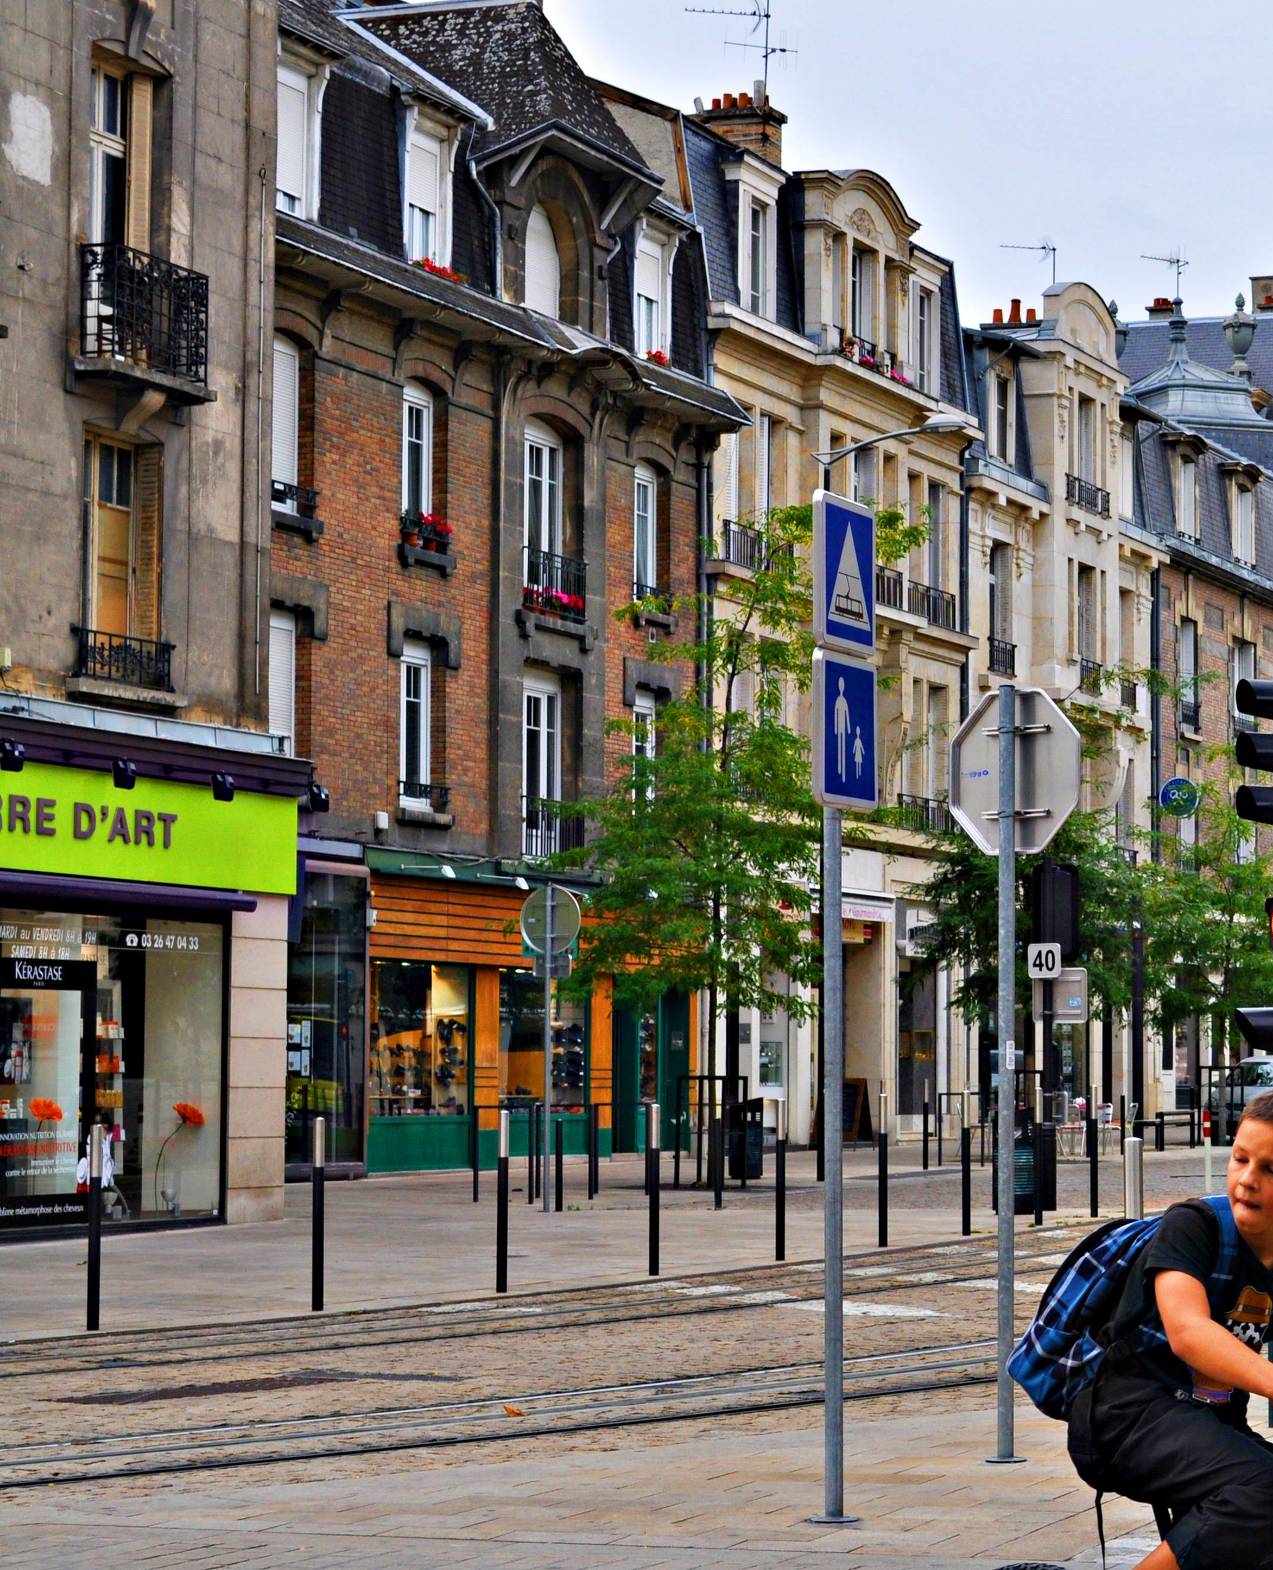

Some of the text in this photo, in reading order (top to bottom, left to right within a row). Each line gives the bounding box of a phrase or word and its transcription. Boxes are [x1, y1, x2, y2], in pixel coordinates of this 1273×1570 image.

[0, 793, 178, 849] RE D'ART
[20, 928, 31, 940] au
[32, 927, 64, 943] VENDREDI
[84, 930, 97, 944] 19H
[141, 934, 199, 950] 03 26 47 04 33
[11, 944, 36, 959] SAMEDI
[38, 945, 48, 959] 8H
[58, 946, 71, 960] 18H
[1032, 949, 1056, 972] 40
[15, 960, 62, 980] KÉRASTASE
[54, 1203, 63, 1213] des
